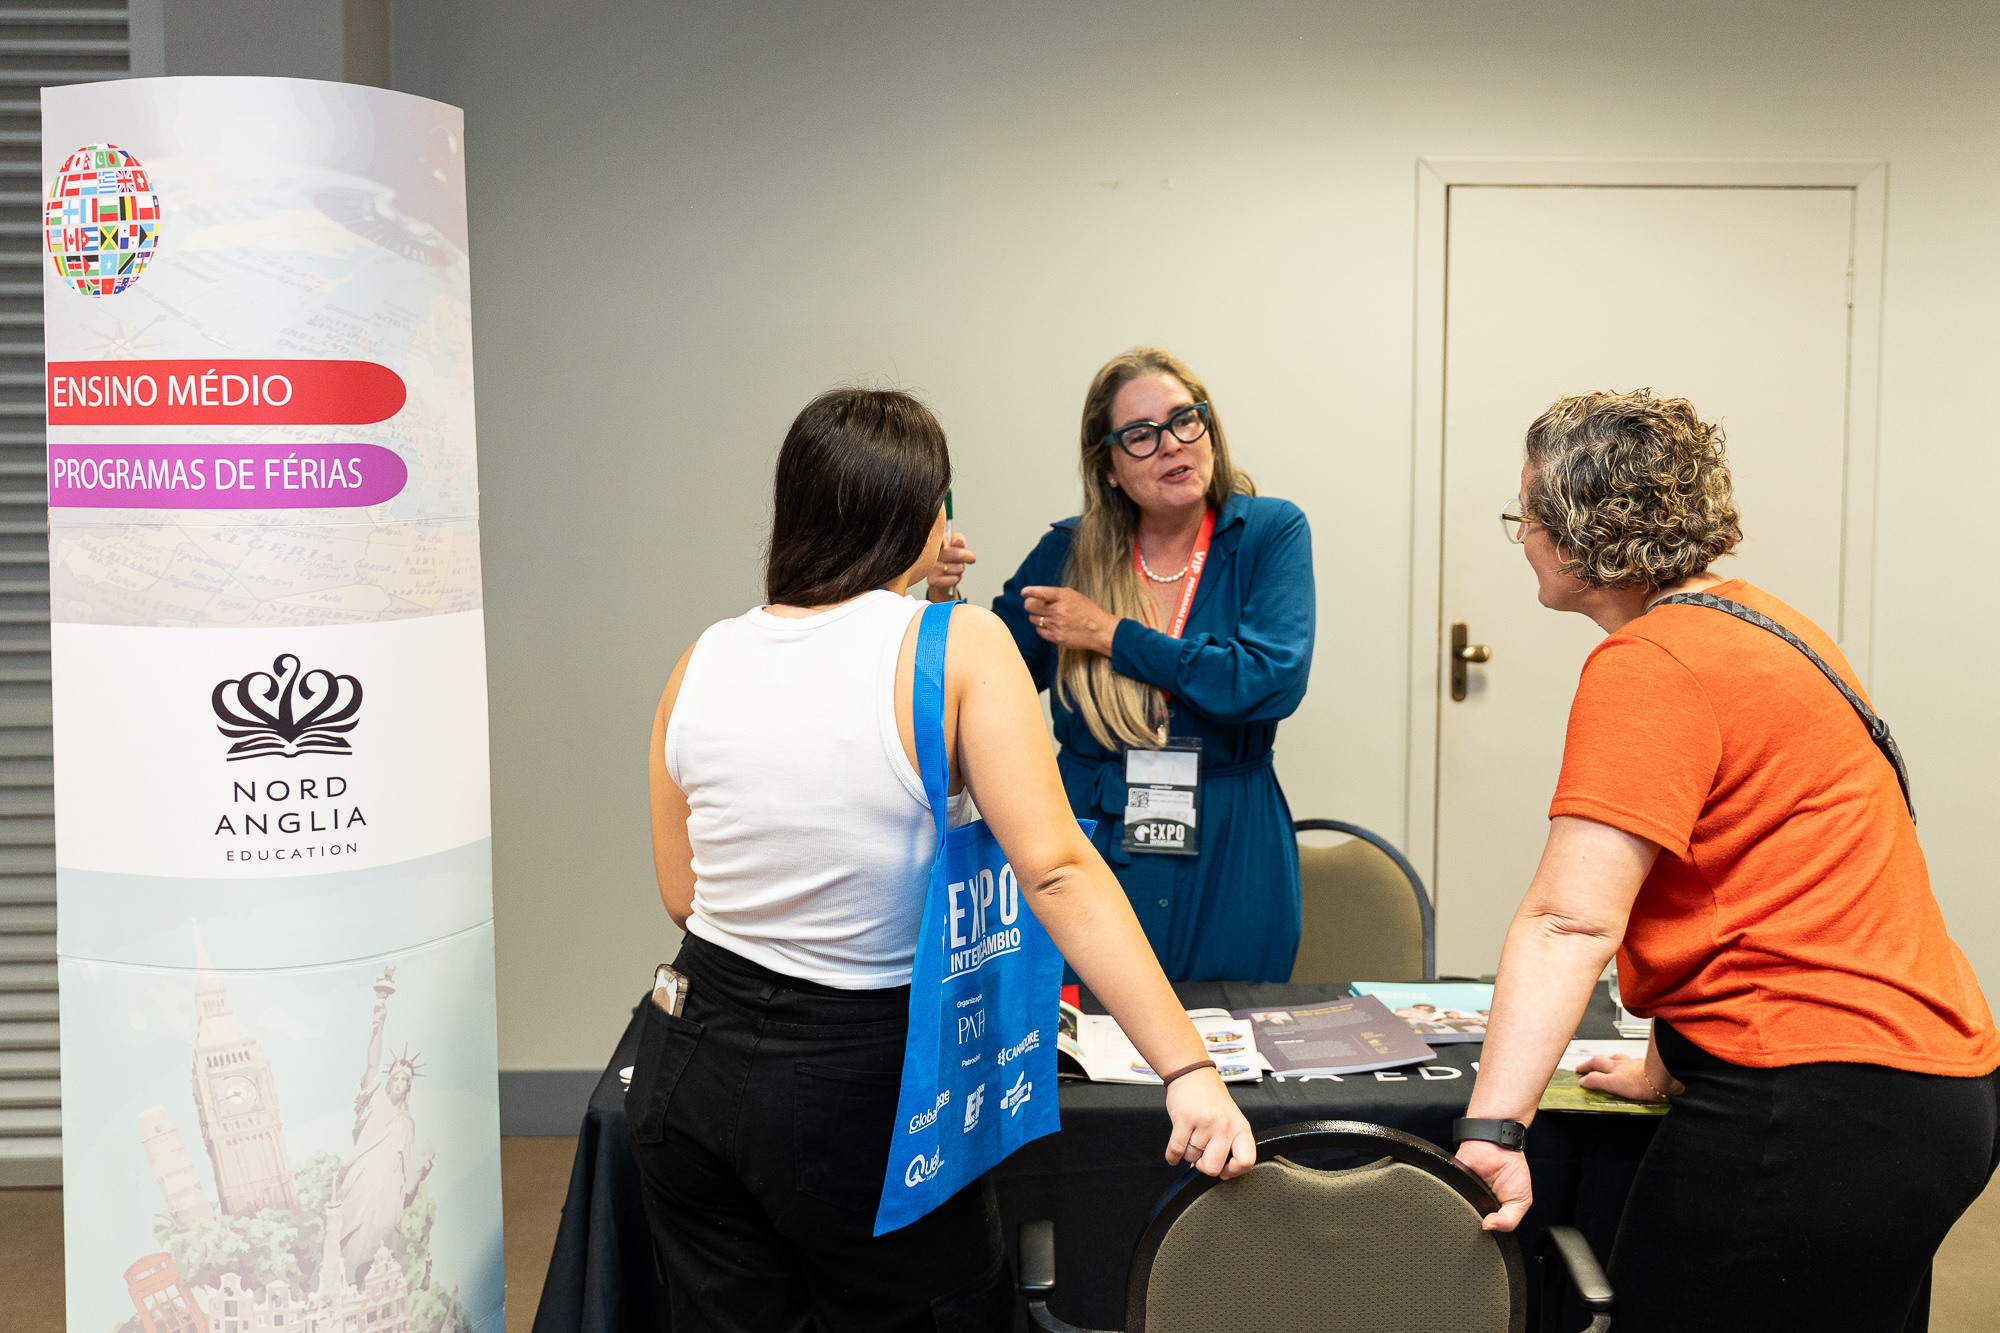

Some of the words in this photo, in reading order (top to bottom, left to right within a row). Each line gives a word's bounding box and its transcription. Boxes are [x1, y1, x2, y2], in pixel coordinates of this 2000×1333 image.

[53, 375, 158, 407] ENSINO
[168, 368, 293, 407] MÉDIO
[54, 458, 206, 490] PROGRAMAS
[214, 458, 256, 490] DE
[264, 453, 363, 490] FÉRIAS
[1191, 551, 1206, 574] VIP
[1178, 576, 1196, 618] PREMIUM
[234, 776, 347, 803] NORD
[214, 806, 367, 836] ANGLIA
[1149, 823, 1185, 841] EXPO
[226, 842, 358, 861] EDUCATION
[947, 862, 1019, 949] EXPO
